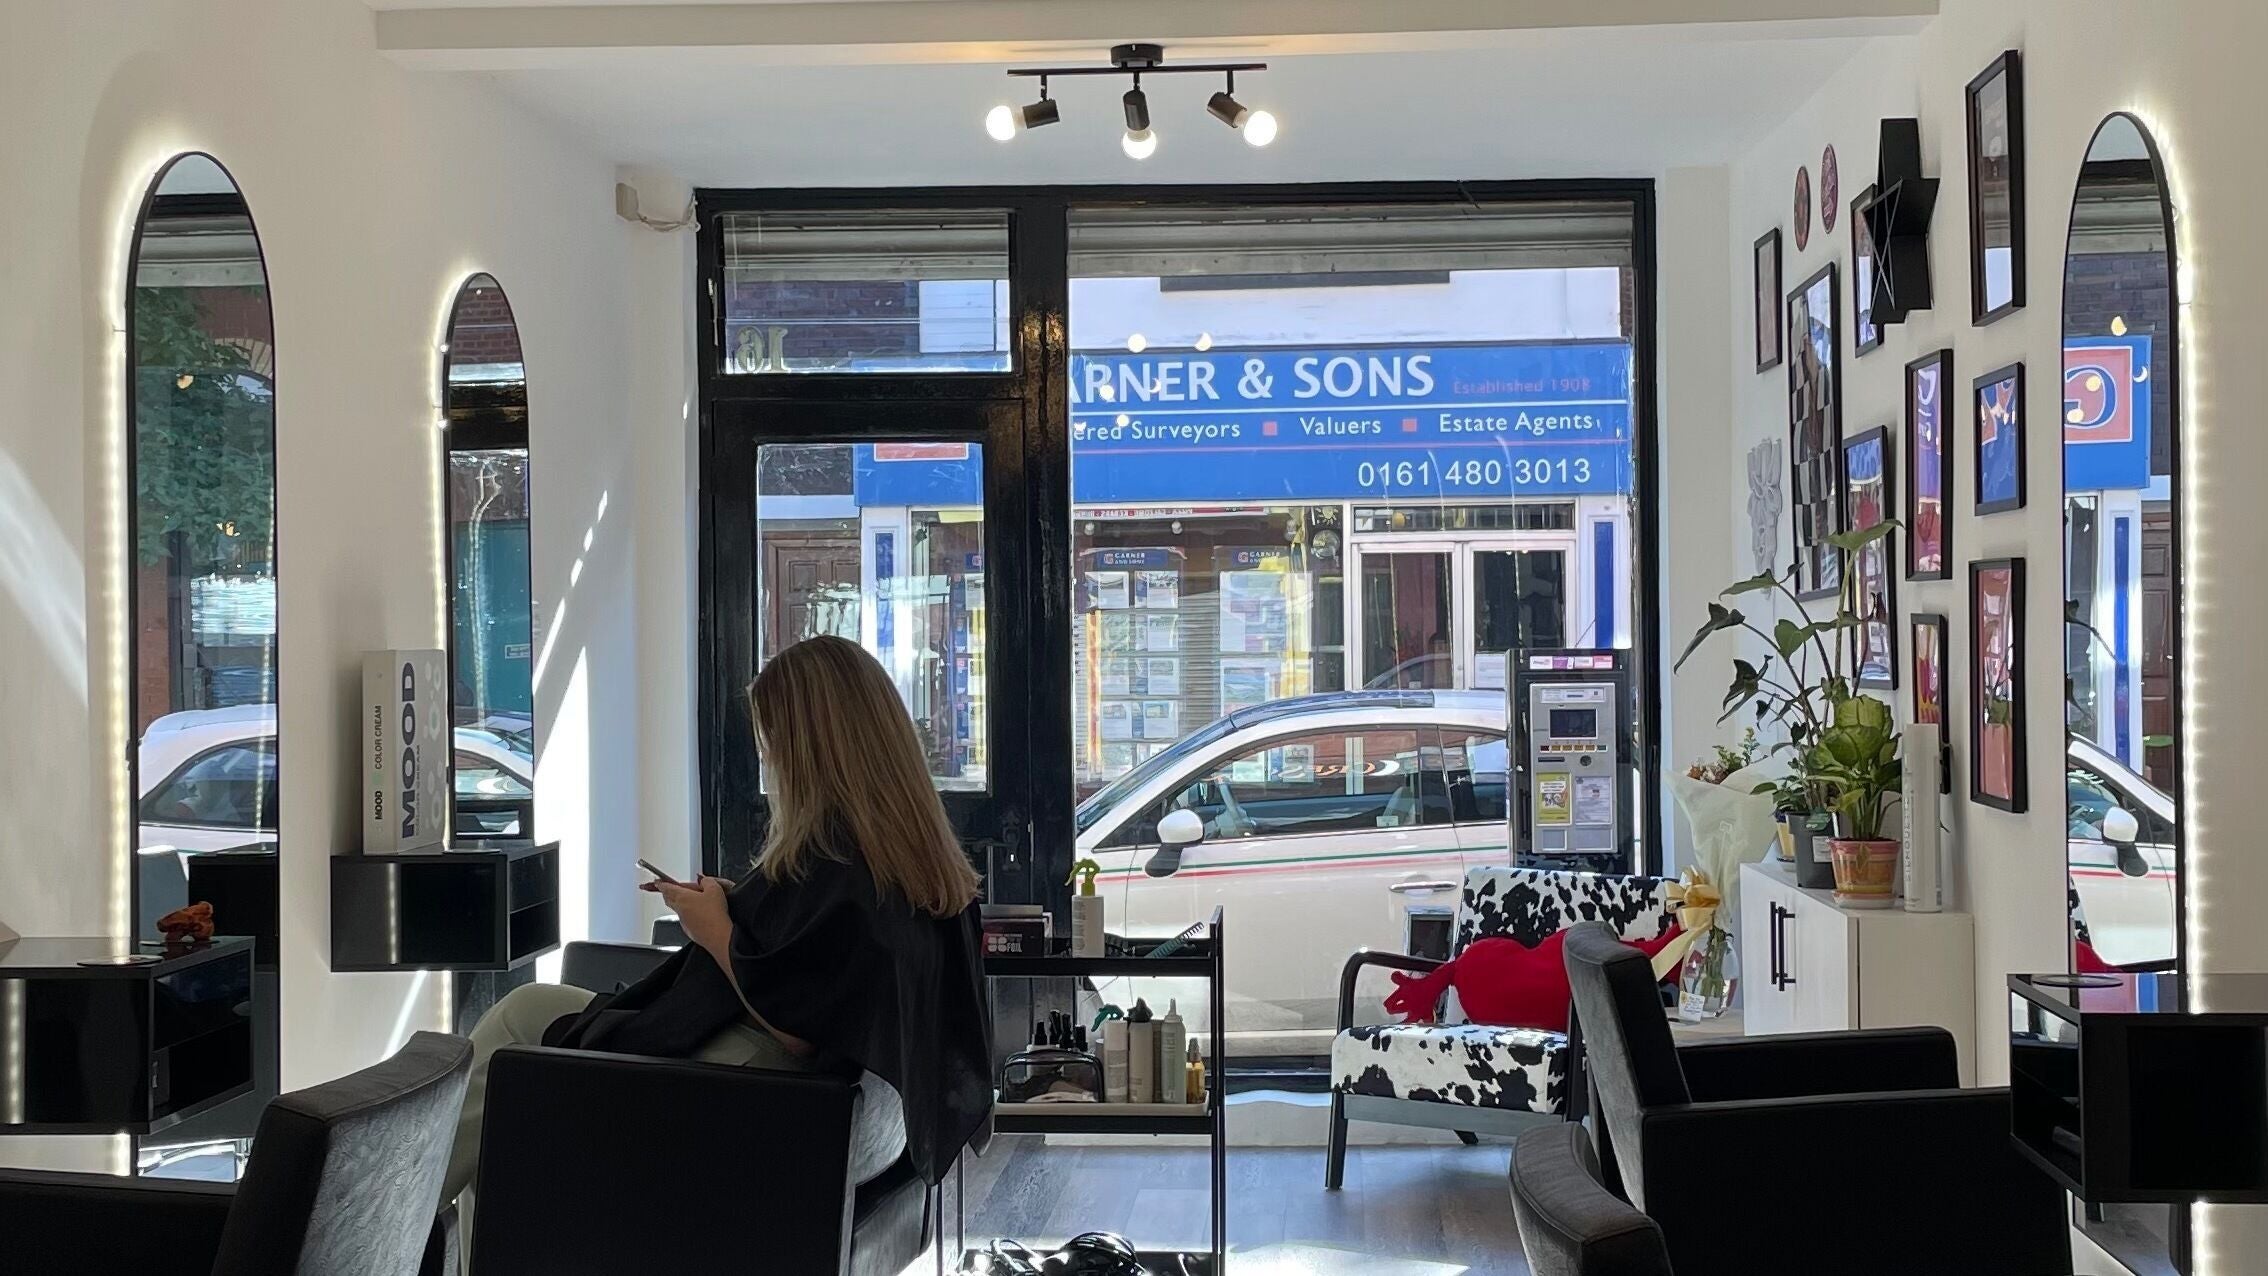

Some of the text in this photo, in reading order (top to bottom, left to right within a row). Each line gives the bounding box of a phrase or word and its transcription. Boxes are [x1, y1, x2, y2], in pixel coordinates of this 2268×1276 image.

[1237, 358, 1274, 400] &
[1293, 354, 1435, 399] SONS
[1453, 378, 1543, 395] Established
[1131, 420, 1241, 444] Surveyors
[1299, 416, 1382, 436] Valuers
[1439, 413, 1508, 433] Estate
[1514, 411, 1593, 436] Agents
[1357, 458, 1592, 487] 0161 480 3013
[374, 705, 384, 820] MOOD COLOR CREAM
[401, 662, 416, 839] MOOD
